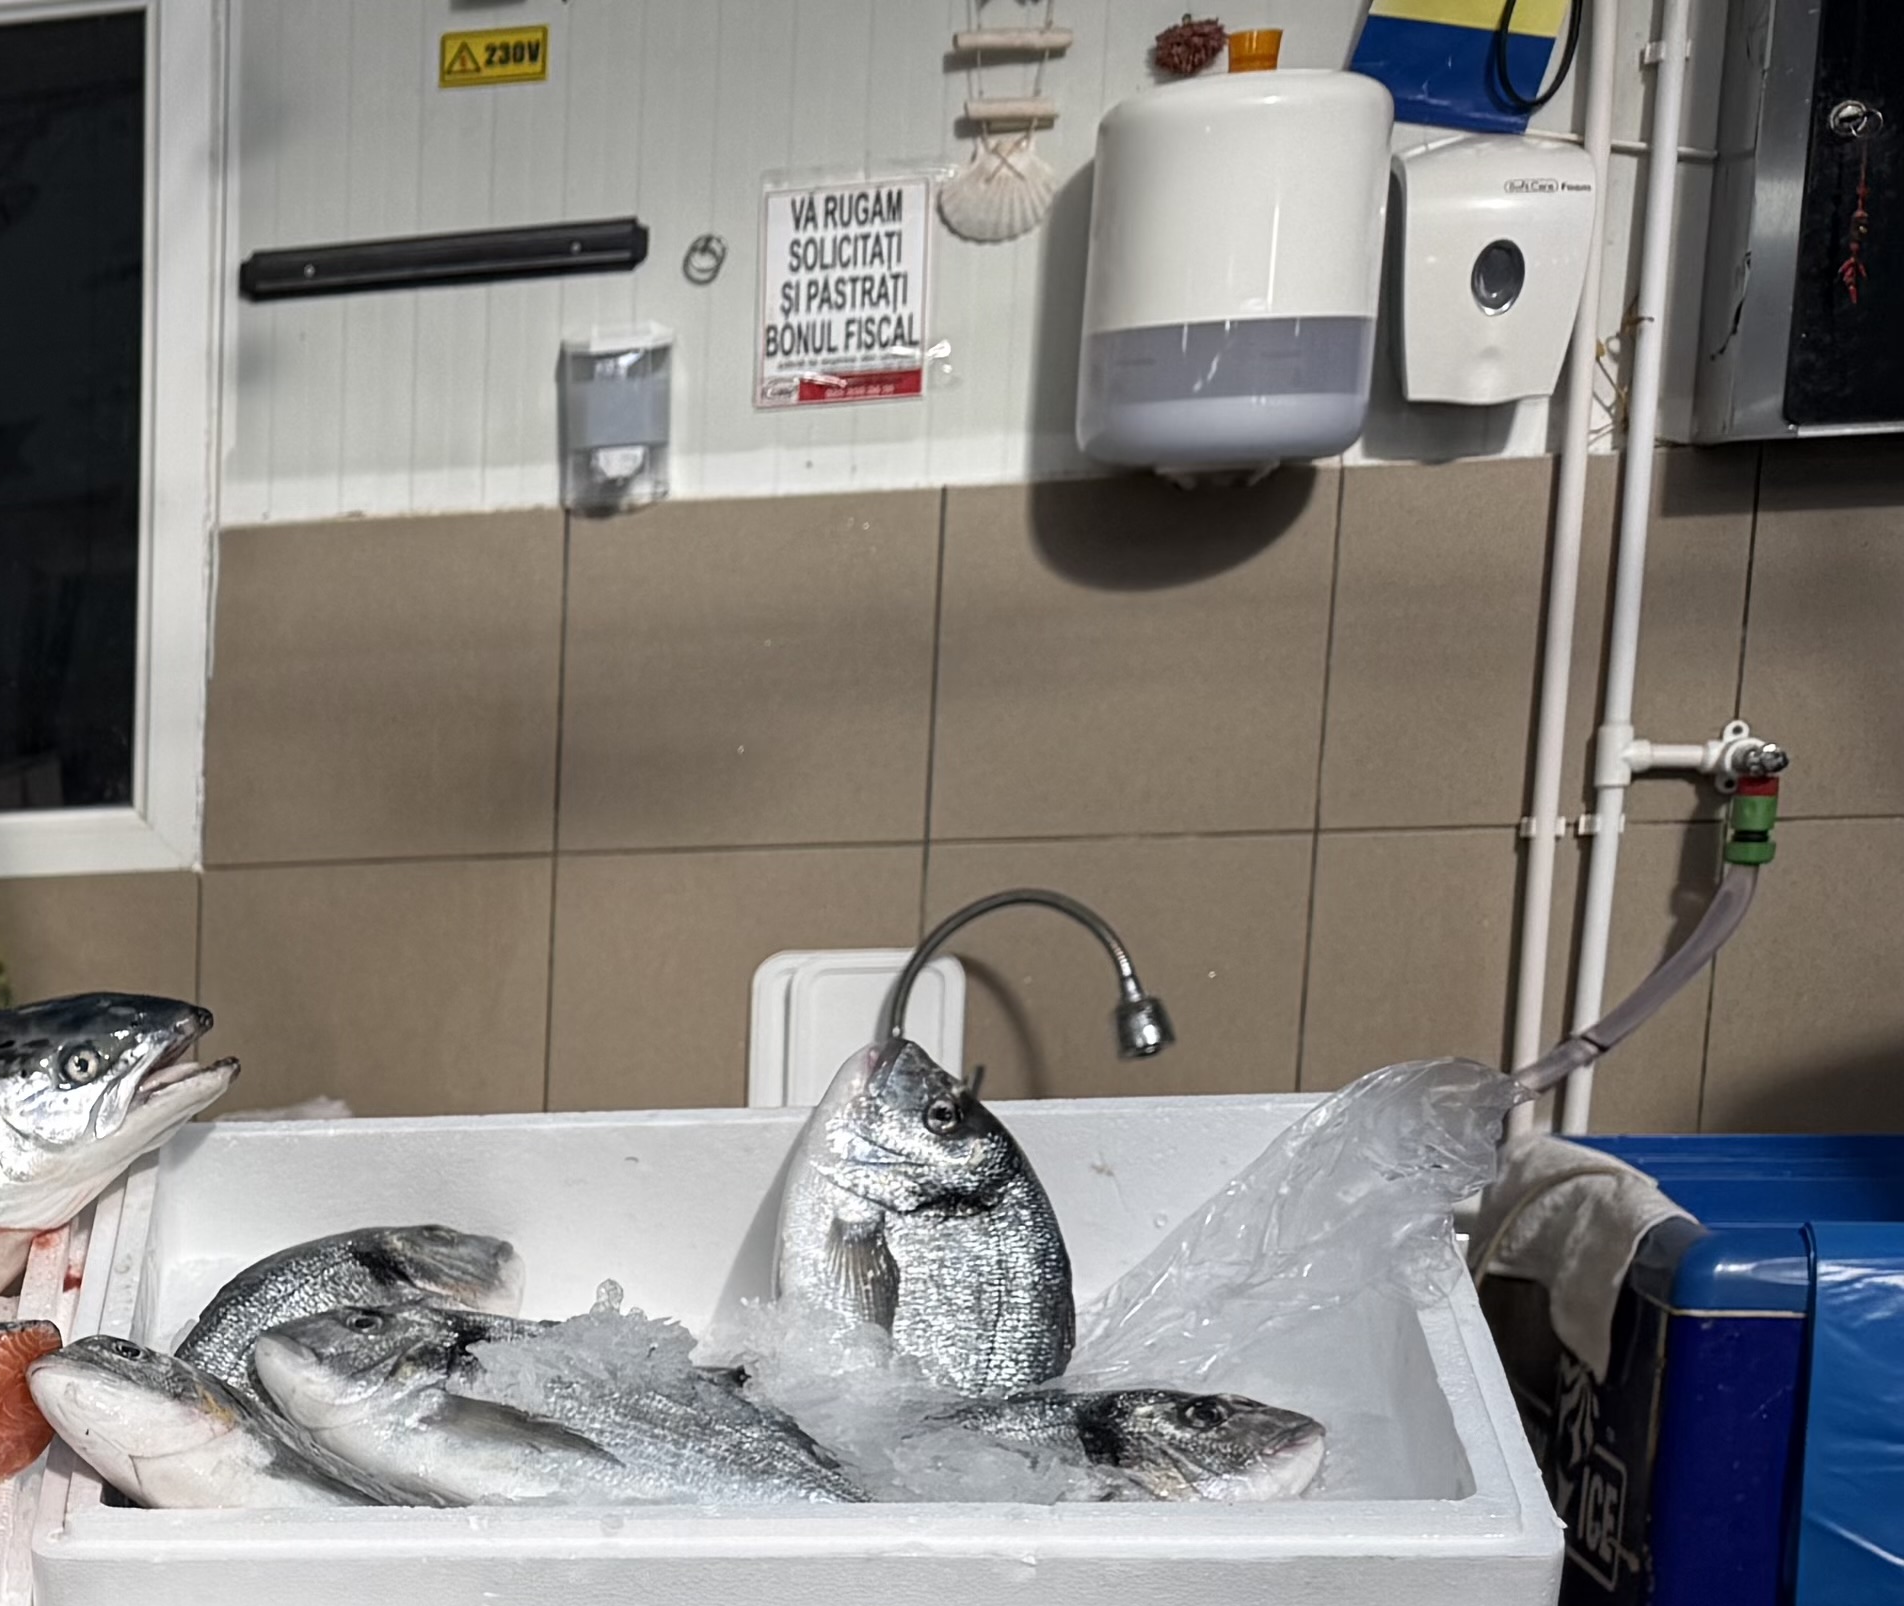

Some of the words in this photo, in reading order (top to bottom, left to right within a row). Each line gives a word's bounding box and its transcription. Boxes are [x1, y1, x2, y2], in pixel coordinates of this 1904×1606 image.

[485, 39, 540, 67] 230V
[789, 230, 903, 273] SOLICITAȚI
[765, 319, 839, 358] BONUL
[844, 312, 920, 350] FISCAL
[1578, 1466, 1618, 1563] ICE
